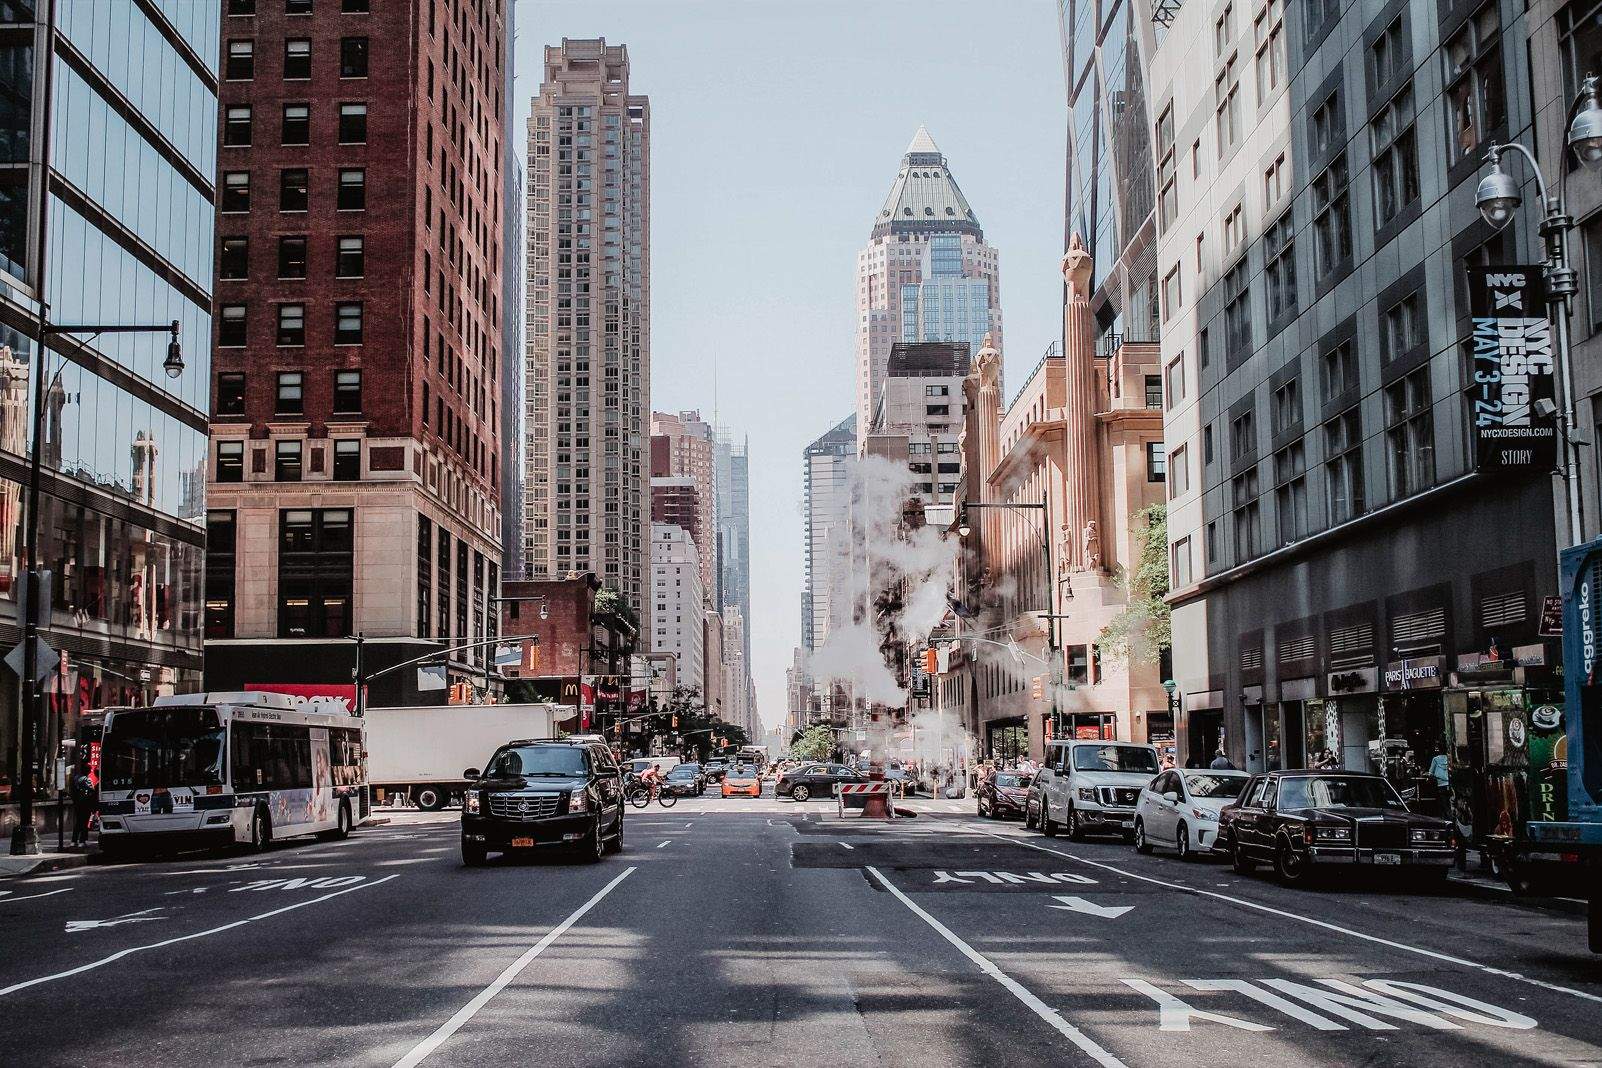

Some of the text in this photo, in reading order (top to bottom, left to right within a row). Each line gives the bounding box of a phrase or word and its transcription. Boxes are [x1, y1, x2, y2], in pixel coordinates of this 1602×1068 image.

[1485, 273, 1526, 288] NYC
[1494, 290, 1523, 311] X
[1471, 317, 1501, 364] MAY
[1523, 317, 1554, 375] NYC
[1497, 317, 1531, 426] DESIGN
[1480, 427, 1554, 439] NYCXDESIGN.COM
[1501, 449, 1533, 466] STORY
[1578, 581, 1594, 675] aggreko
[1385, 669, 1403, 683] PARIS
[1405, 665, 1437, 680] BAGUETTE
[932, 870, 1100, 884] ONLY
[1118, 977, 1539, 1032] ONLY
